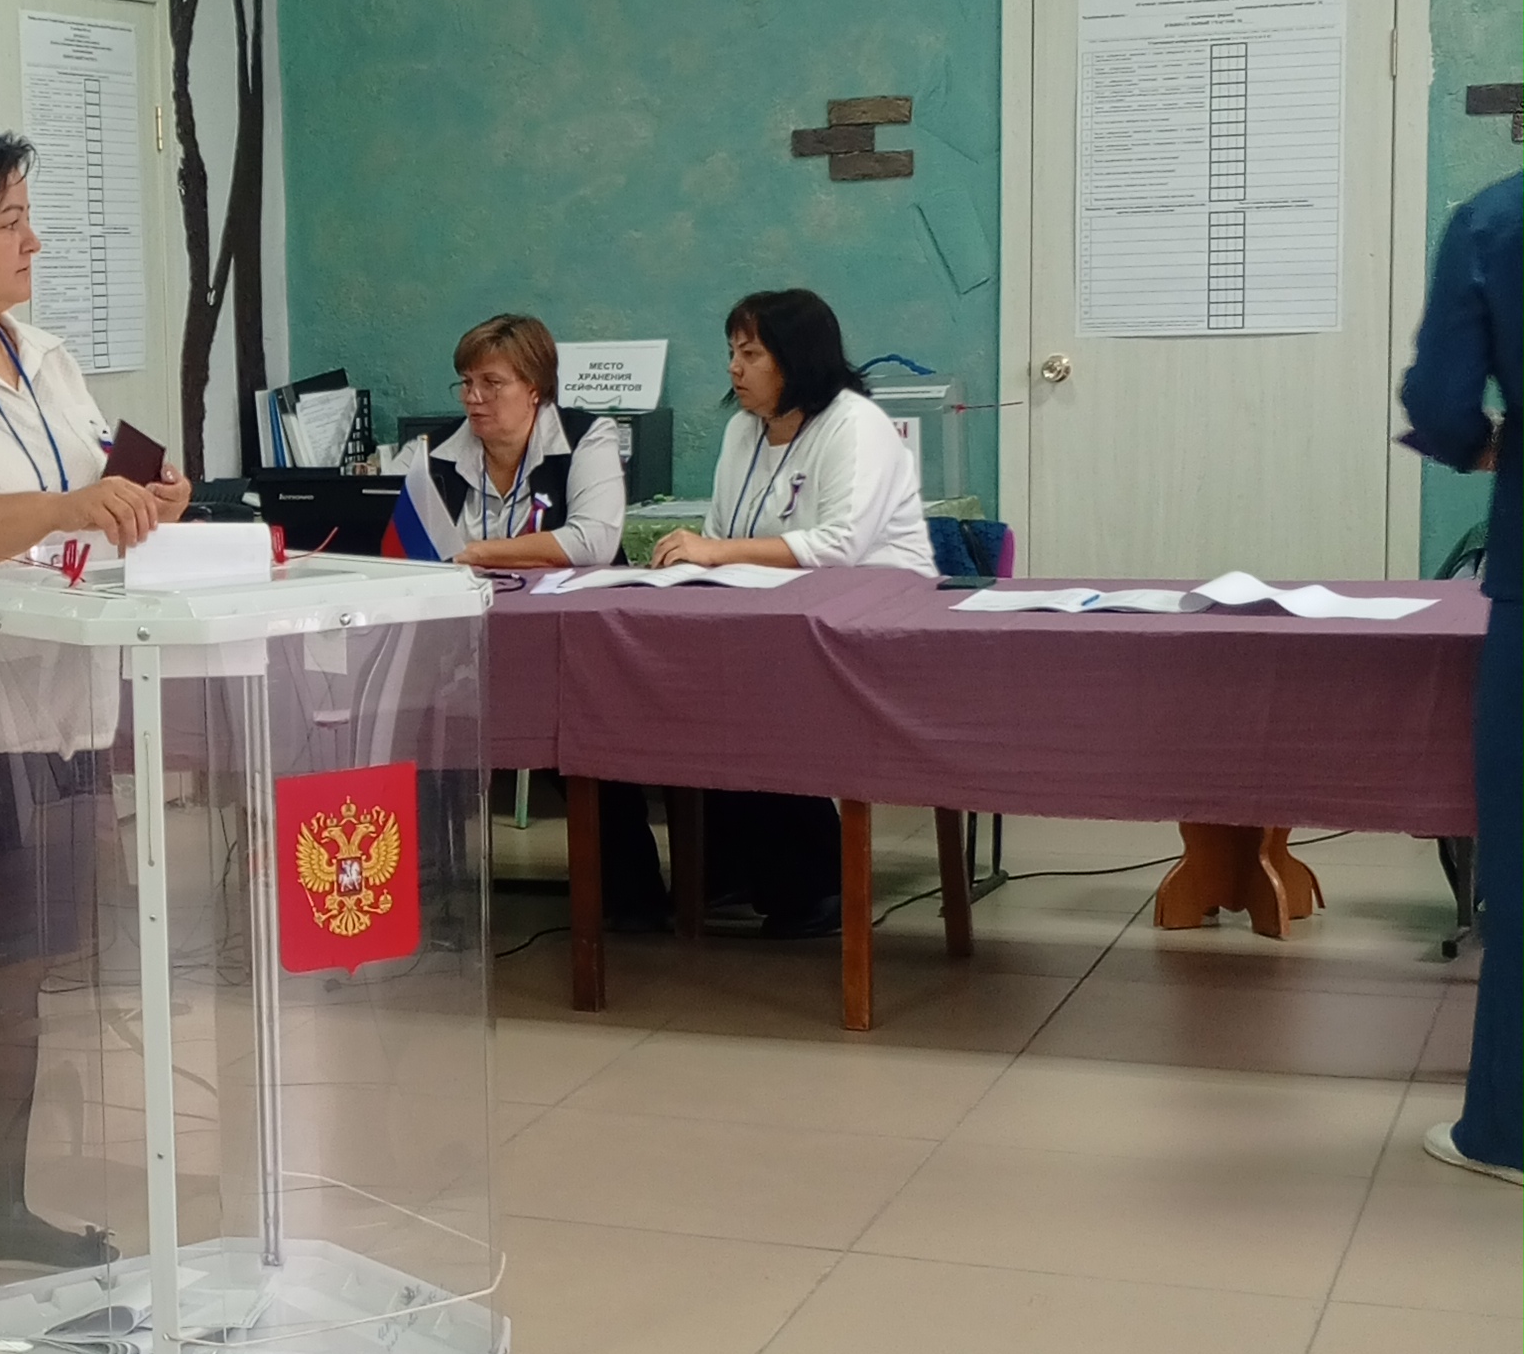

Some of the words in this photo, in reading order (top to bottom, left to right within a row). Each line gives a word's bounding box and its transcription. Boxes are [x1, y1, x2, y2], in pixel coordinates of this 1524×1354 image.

[588, 362, 625, 371] МЕСТО
[577, 373, 633, 382] ХРАНЕНИЯ
[564, 383, 643, 392] СЕЙФ-ПАКЕТОВ
